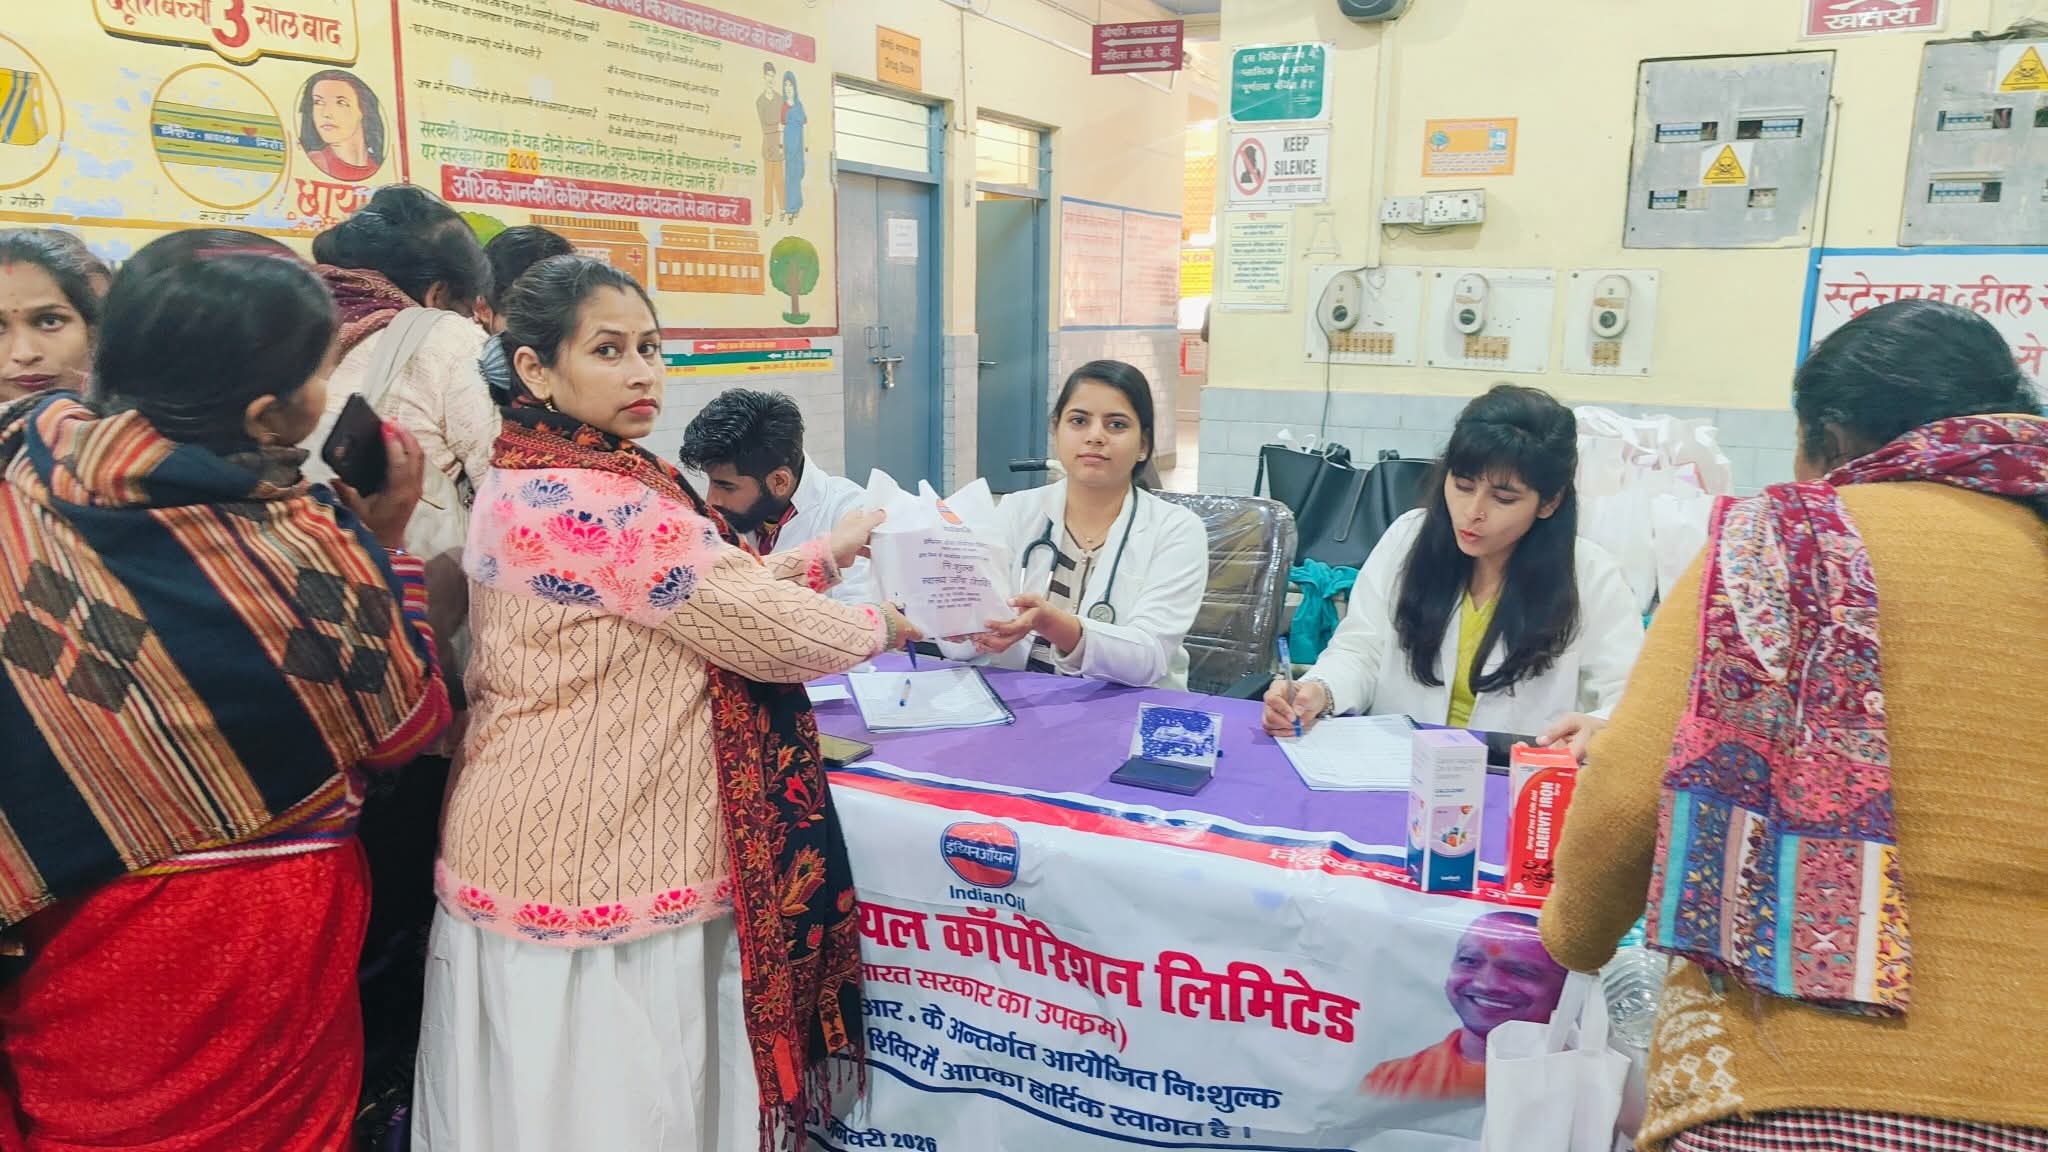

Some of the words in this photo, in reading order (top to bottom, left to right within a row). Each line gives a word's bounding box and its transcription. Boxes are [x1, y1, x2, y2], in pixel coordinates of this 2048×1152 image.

[213, 0, 250, 48] 3
[252, 5, 297, 39] साल
[300, 14, 341, 44] बाद
[1282, 136, 1310, 152] KEEP
[509, 152, 539, 171] 2000
[1273, 159, 1318, 176] SILENCE
[452, 170, 500, 203] अधिक
[1539, 782, 1554, 808] IRON
[1534, 812, 1553, 860] ELDERVIT
[949, 885, 1026, 912] IndianOil
[857, 901, 930, 951] यल
[1154, 951, 1361, 1043] लिमिटेड
[915, 969, 995, 1007] सरकार
[997, 987, 1032, 1019] का
[1036, 998, 1128, 1053] उपक्रम)
[920, 1003, 946, 1031] के
[947, 1016, 1037, 1062] अन्तर्गत
[1042, 1048, 1158, 1092] आयोजित
[866, 1026, 922, 1068] शिविर
[940, 1060, 1025, 1094] आपका
[1028, 1076, 1105, 1119] हार्दिक
[1108, 1102, 1203, 1139] स्वागत
[1204, 1117, 1233, 1140] है
[890, 1132, 938, 1152] 2026
